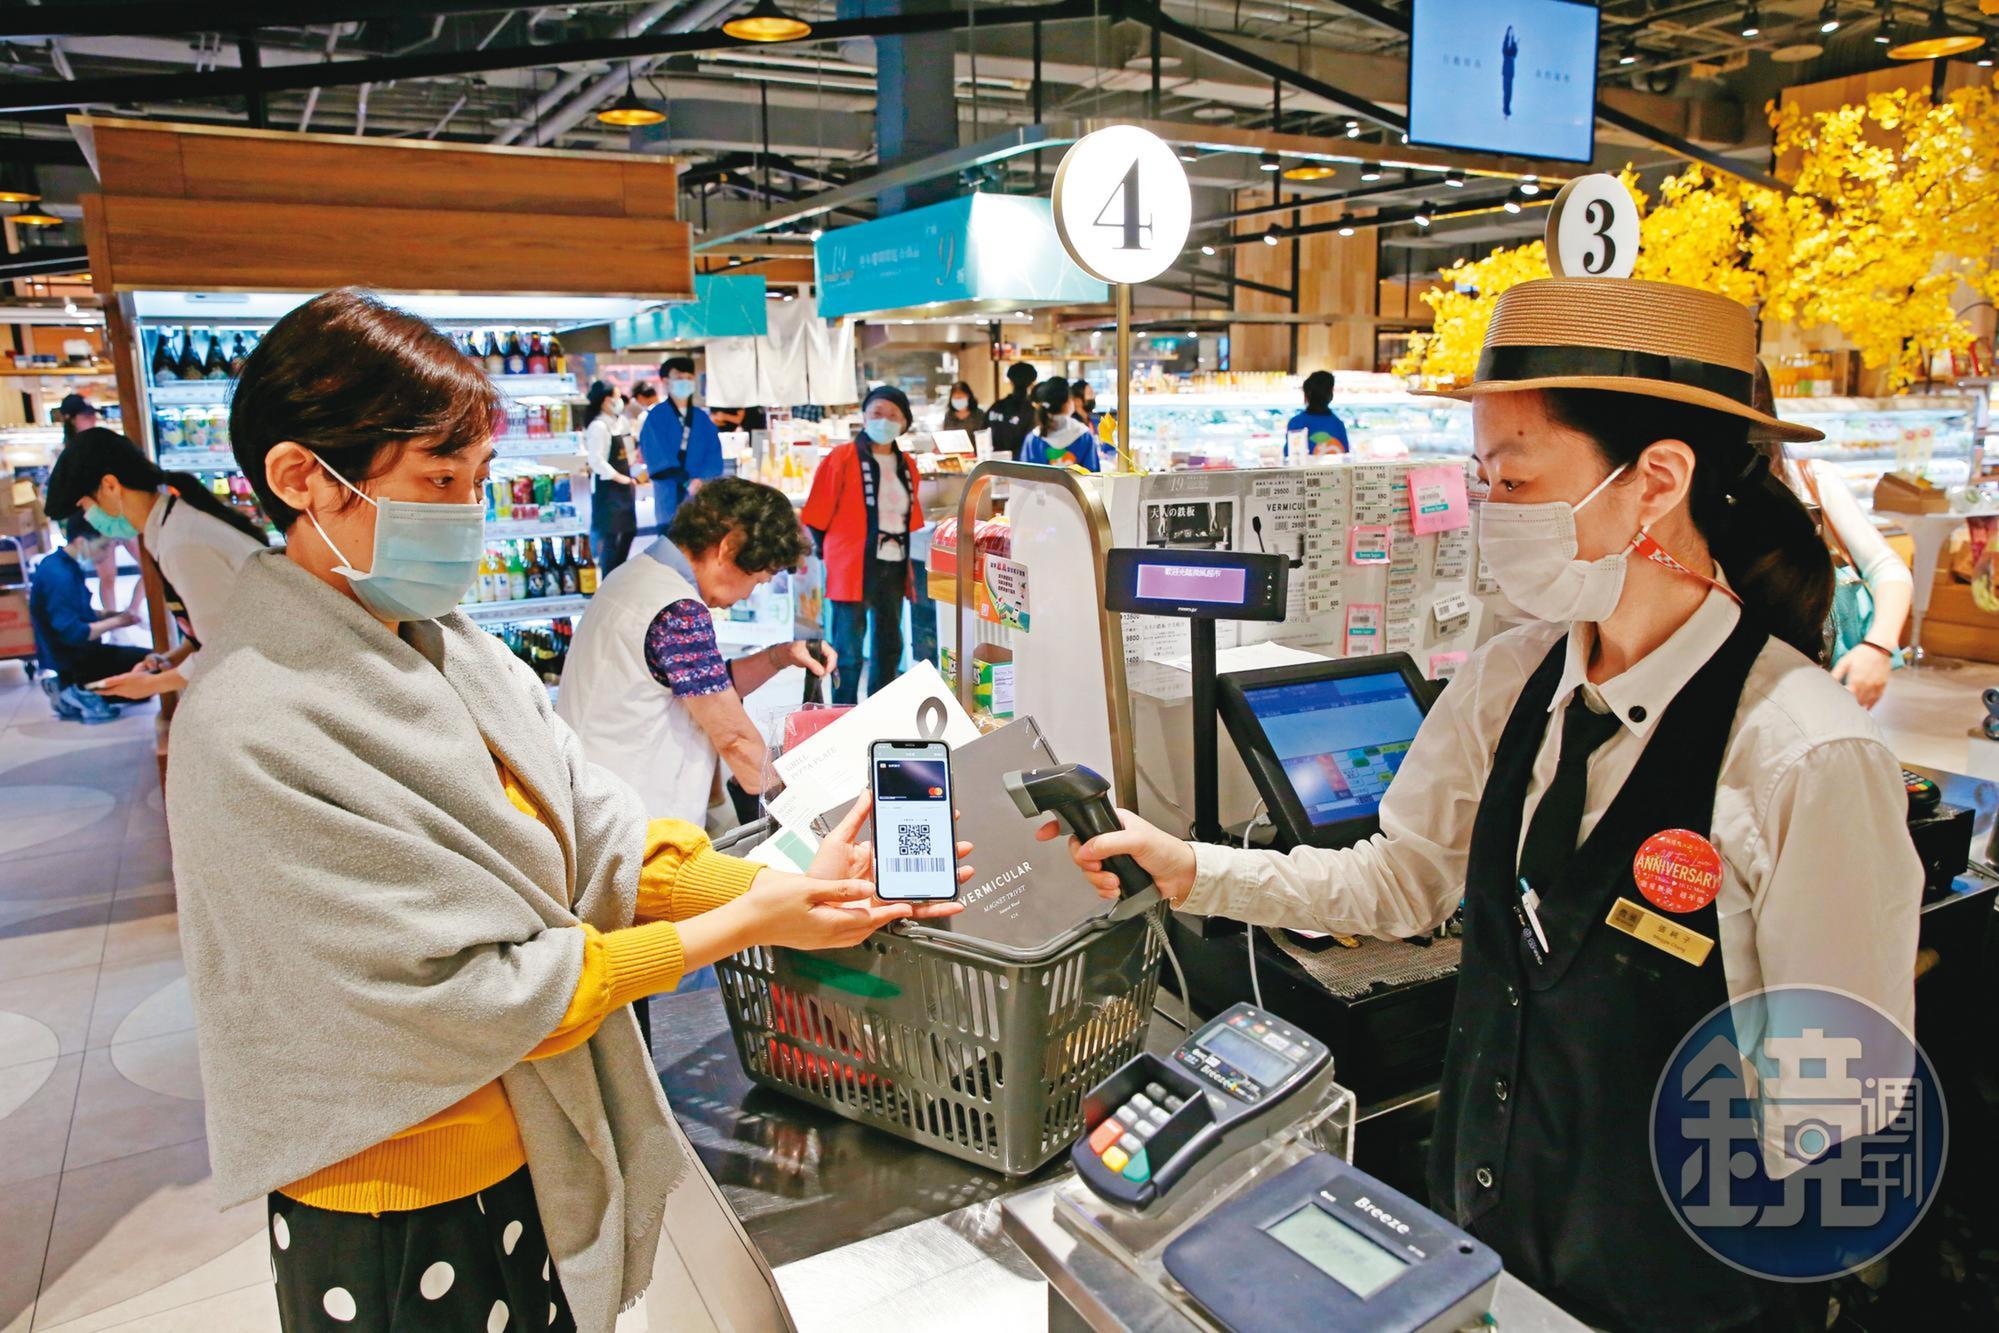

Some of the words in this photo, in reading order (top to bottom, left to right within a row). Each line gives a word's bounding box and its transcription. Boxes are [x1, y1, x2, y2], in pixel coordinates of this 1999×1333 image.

[1093, 157, 1153, 250] 4
[1583, 199, 1616, 275] 3
[959, 861, 1032, 907] VERMICULAR
[1636, 854, 1719, 889] ANNIVERSARY
[1354, 1196, 1411, 1235] Breeze
